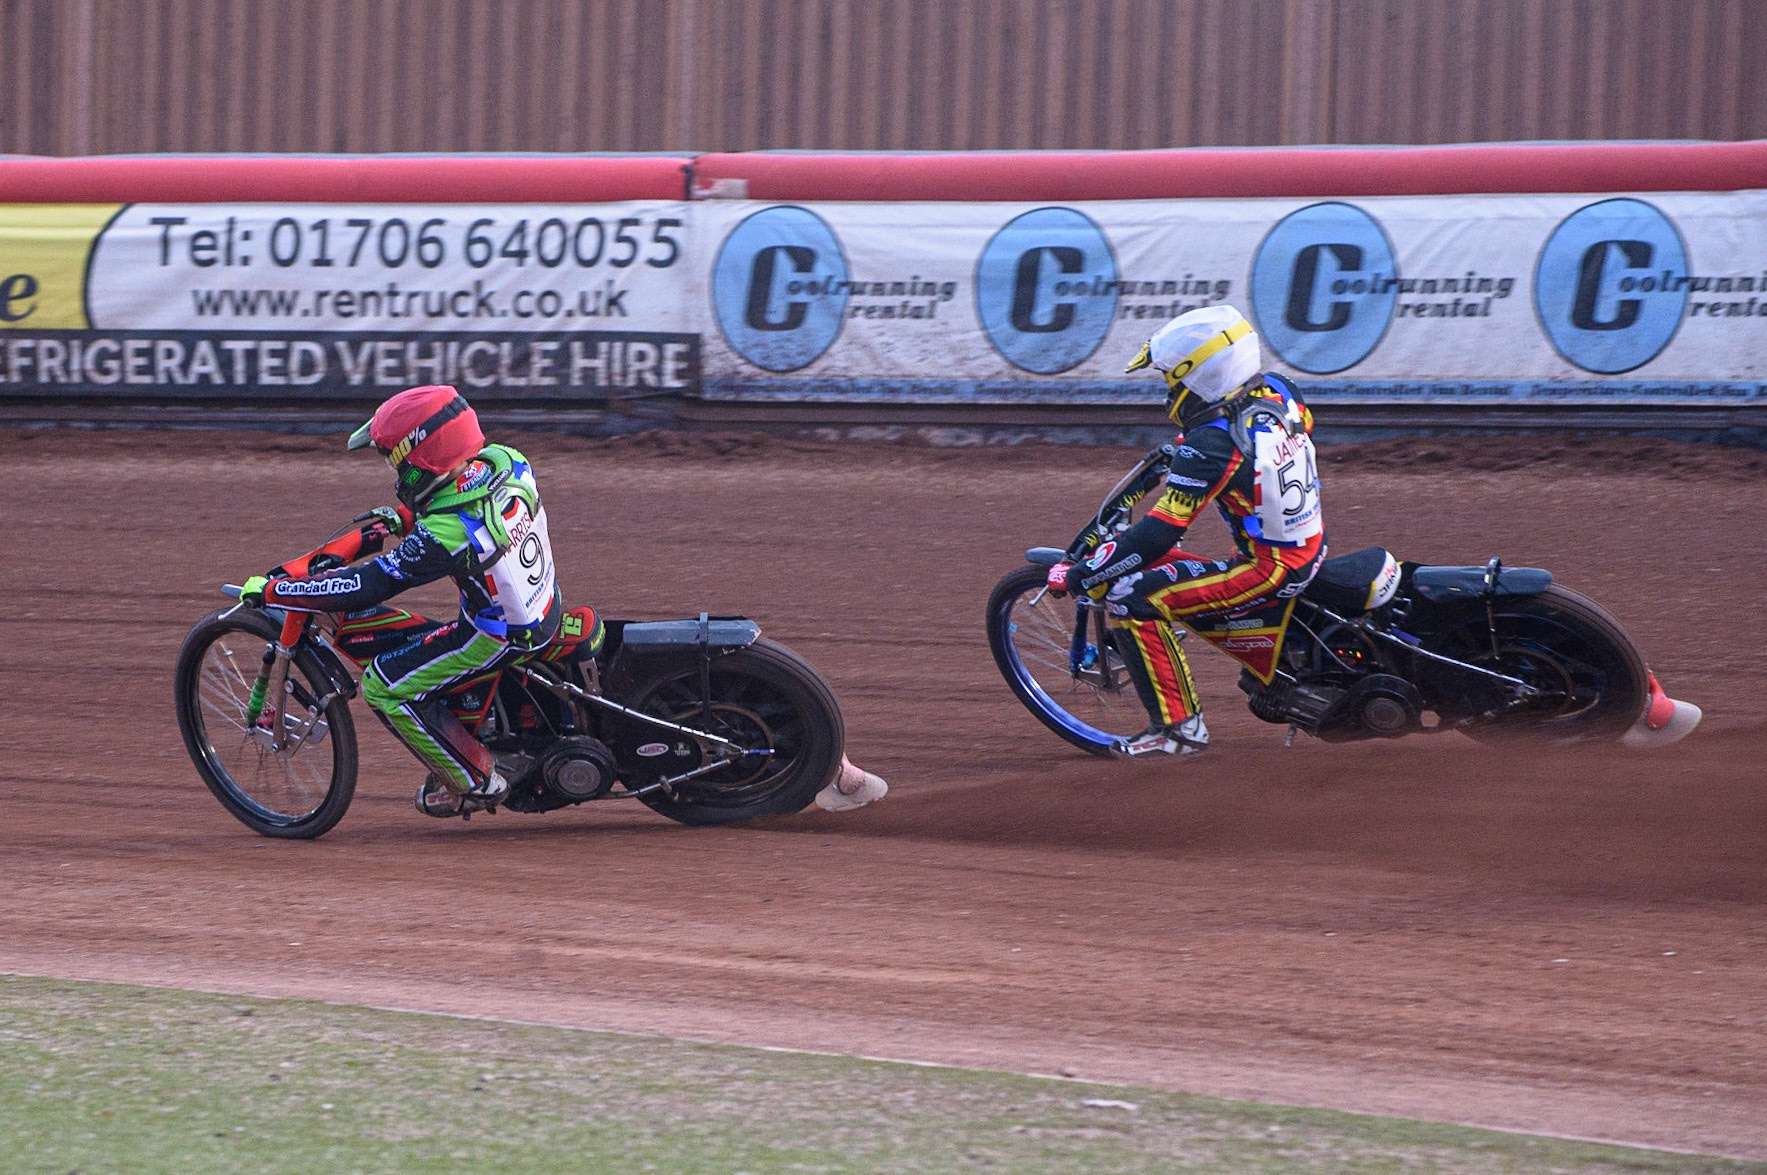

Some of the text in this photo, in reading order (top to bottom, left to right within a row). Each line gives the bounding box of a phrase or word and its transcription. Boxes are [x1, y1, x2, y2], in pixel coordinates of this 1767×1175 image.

[150, 216, 684, 269] Tel: 01706 640055
[192, 280, 629, 319] www.rentruck.co.uk
[849, 301, 939, 319] rental
[1397, 298, 1492, 318] rental
[334, 340, 563, 386] VEHICLE
[571, 342, 690, 388] HIRE
[1278, 445, 1319, 516] 54
[519, 532, 545, 585] 9
[277, 574, 360, 595] Grandad Fred
